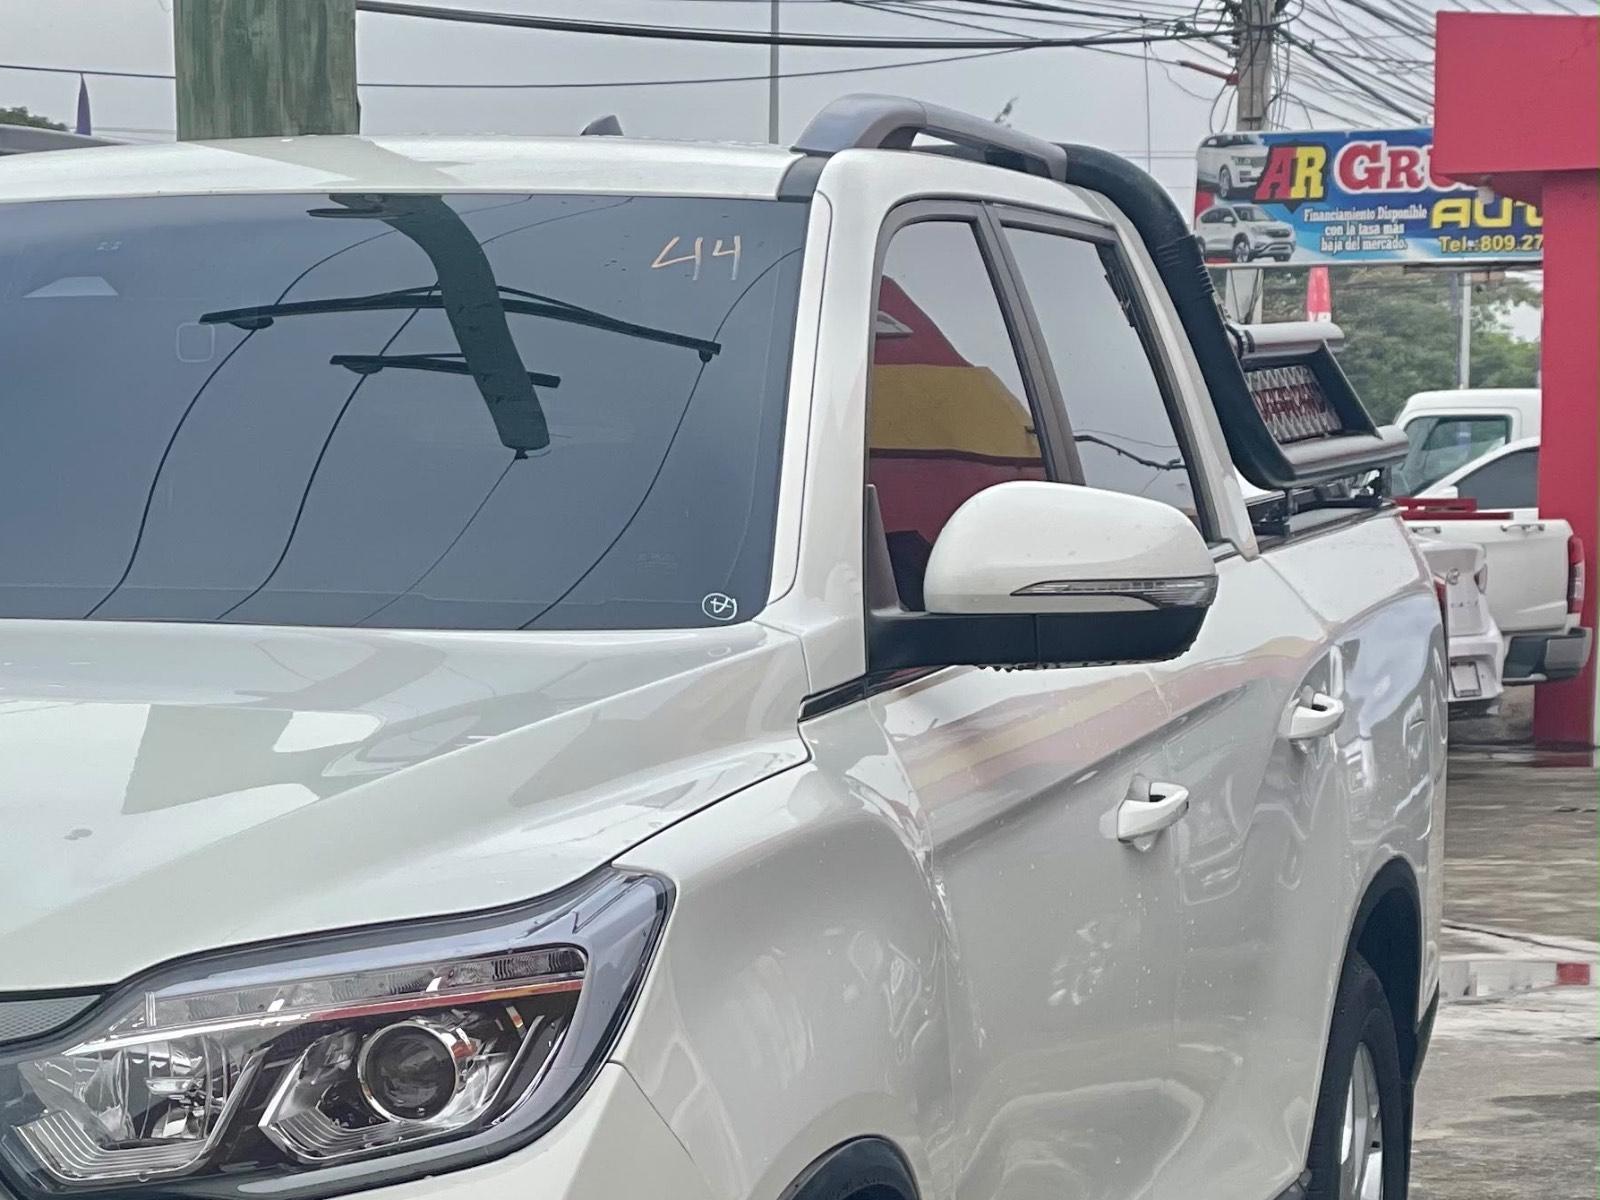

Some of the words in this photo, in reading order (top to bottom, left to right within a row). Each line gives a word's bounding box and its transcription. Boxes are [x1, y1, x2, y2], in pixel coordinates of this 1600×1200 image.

[1254, 146, 1328, 200] AR
[1304, 206, 1376, 222] Financiamiento
[1377, 203, 1427, 222] Disponible
[1325, 225, 1343, 236] con
[1346, 221, 1356, 236] la
[1358, 223, 1381, 235] tasa
[1321, 236, 1343, 254] baja
[1345, 236, 1360, 250] del
[651, 235, 741, 281] 44
